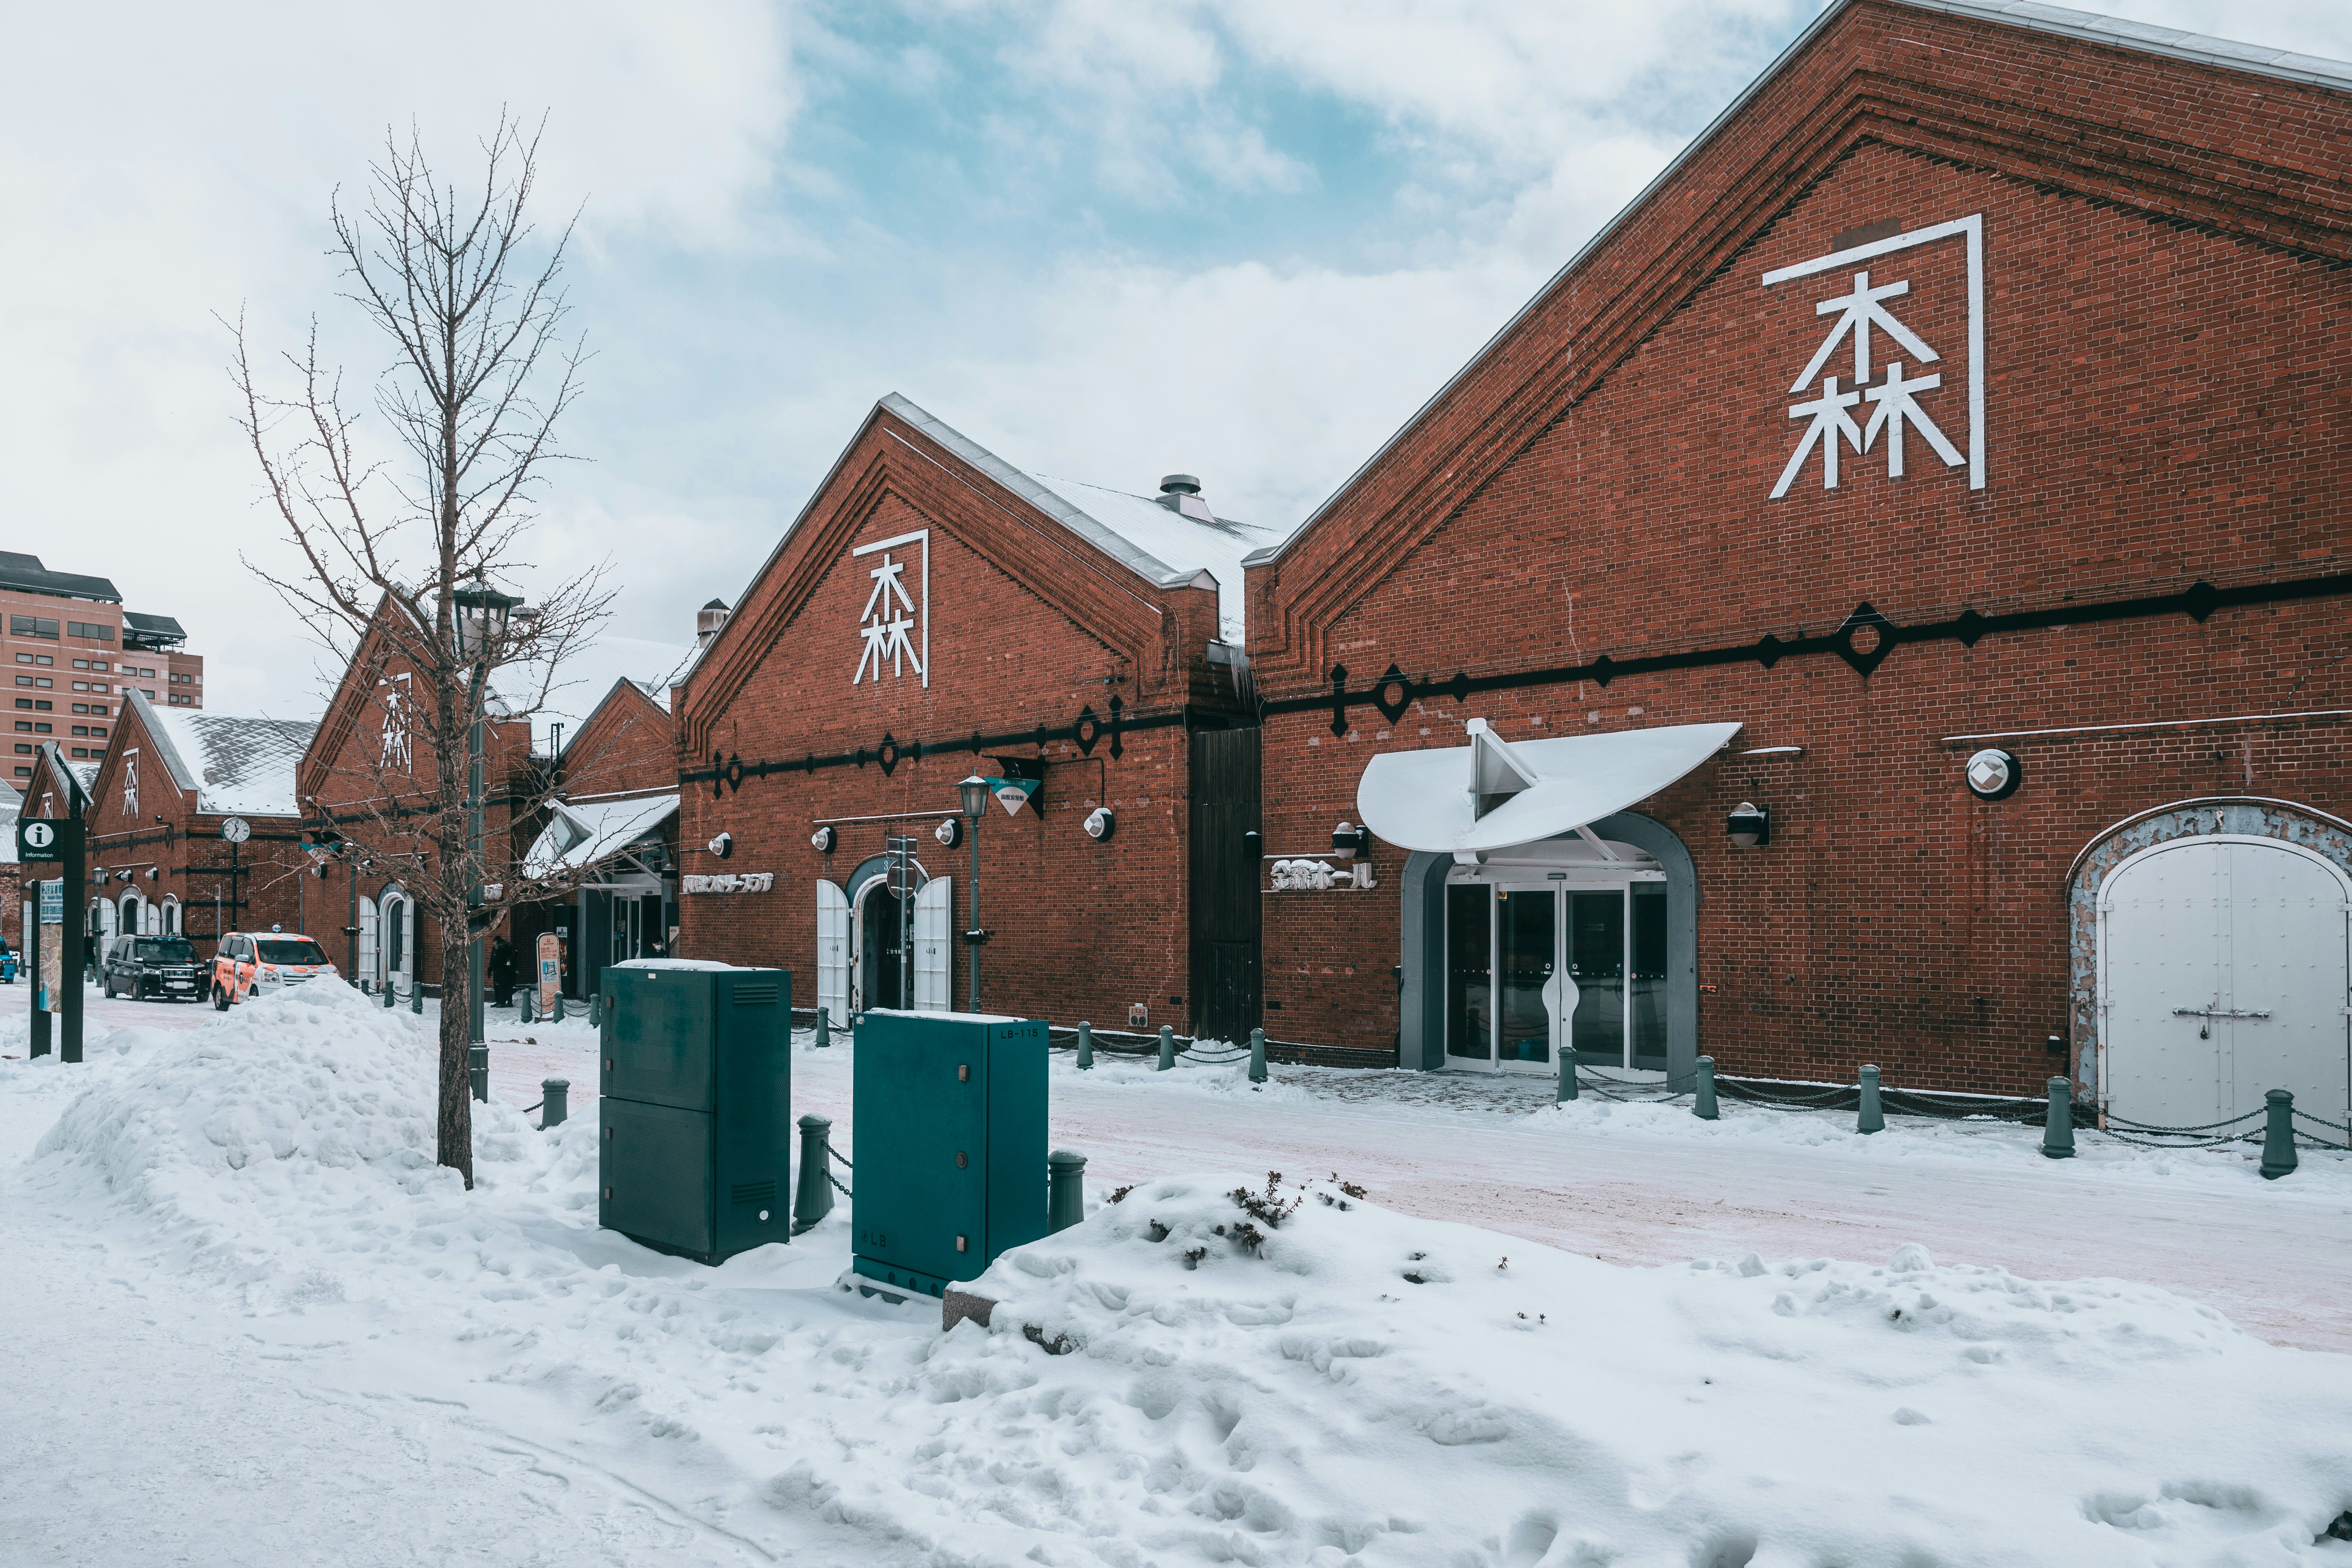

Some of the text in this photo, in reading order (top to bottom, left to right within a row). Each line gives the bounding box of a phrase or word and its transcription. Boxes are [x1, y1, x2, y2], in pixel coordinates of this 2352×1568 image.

[884, 860, 888, 871] 3
[1270, 860, 1377, 890] 金森ホール
[1001, 1029, 1038, 1039] LB-115
[871, 1232, 886, 1247] LB
